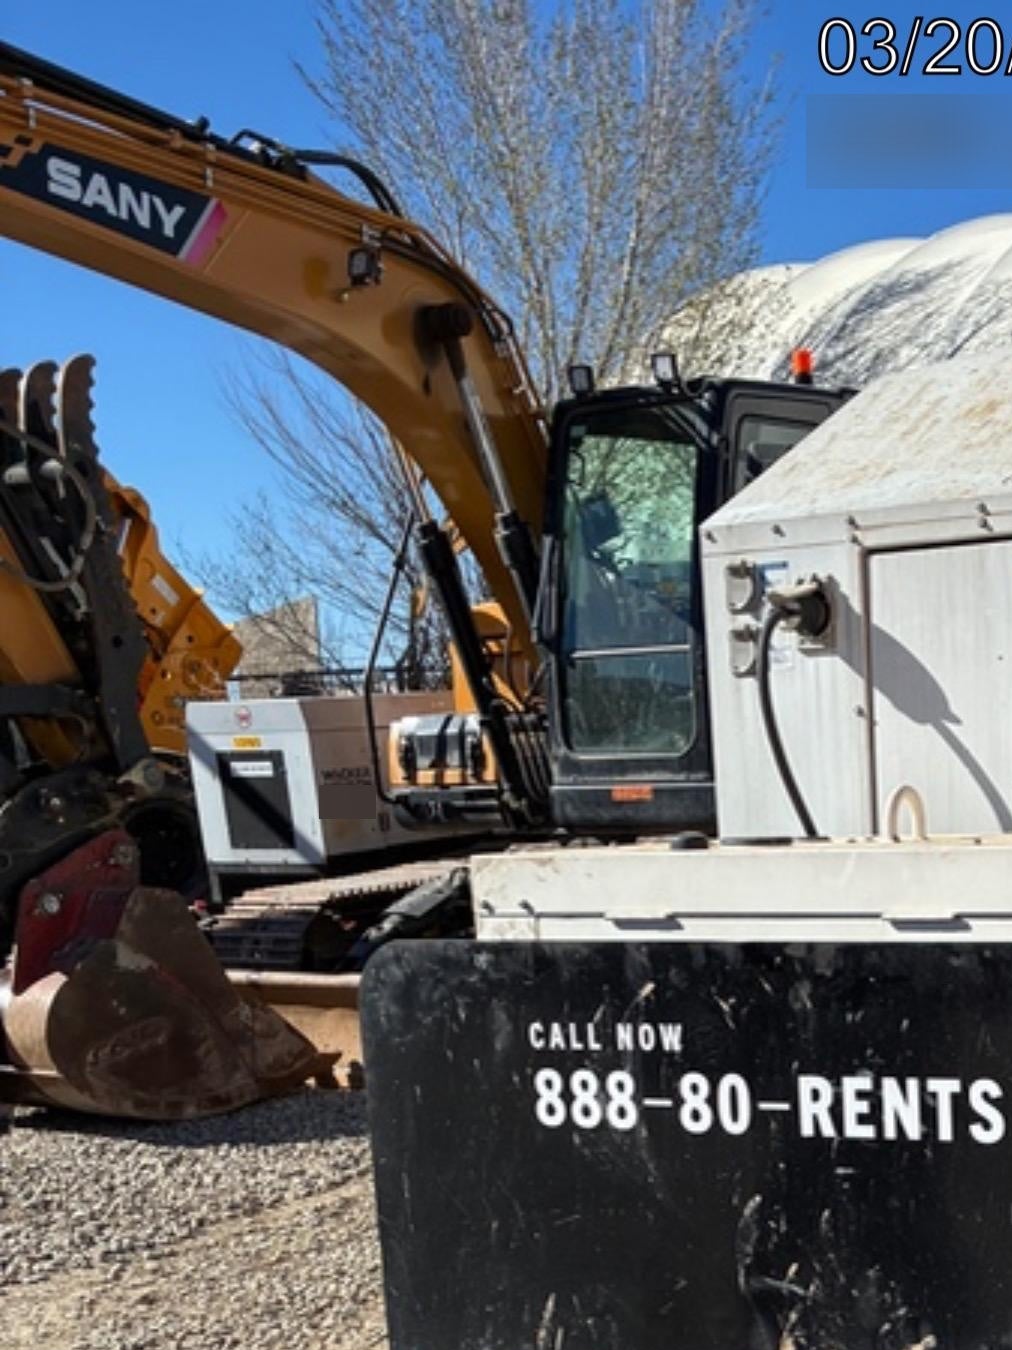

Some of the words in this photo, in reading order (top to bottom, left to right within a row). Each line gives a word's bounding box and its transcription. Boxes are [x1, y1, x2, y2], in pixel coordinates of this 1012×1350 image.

[47, 157, 186, 238] SANY
[529, 1022, 602, 1051] CALL
[616, 1022, 683, 1052] NOW
[534, 1067, 1006, 1144] 888-80-RENTS
